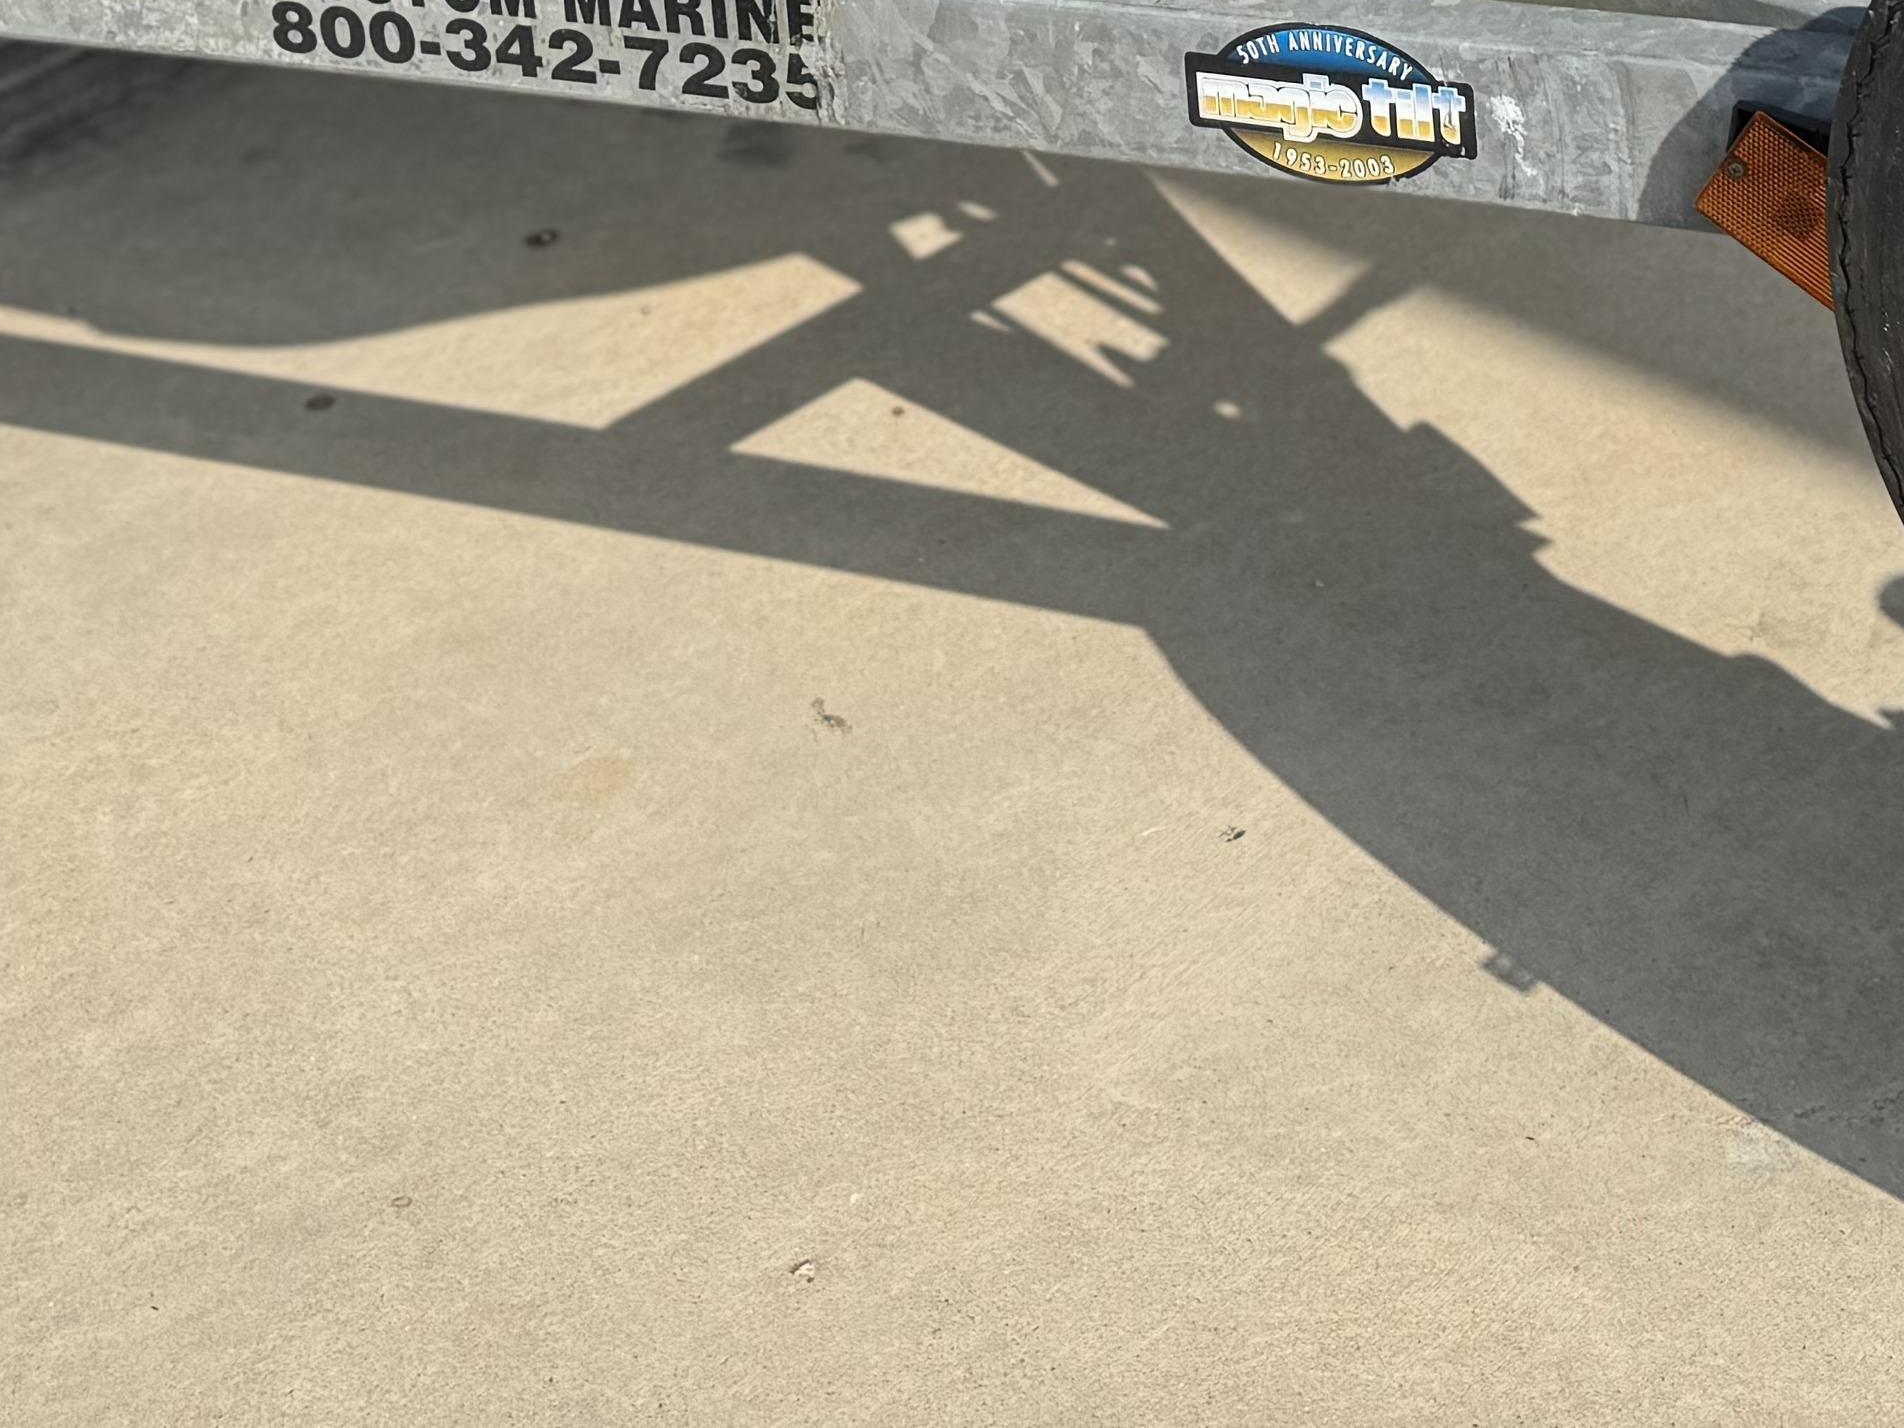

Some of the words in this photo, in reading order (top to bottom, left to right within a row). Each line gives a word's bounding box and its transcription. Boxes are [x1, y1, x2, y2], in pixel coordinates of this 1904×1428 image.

[270, 0, 819, 111] 800-342-7235
[1235, 33, 1281, 66] 50TH
[1287, 30, 1414, 82] ANNIVERSARY
[1272, 141, 1396, 180] 1953-2003
